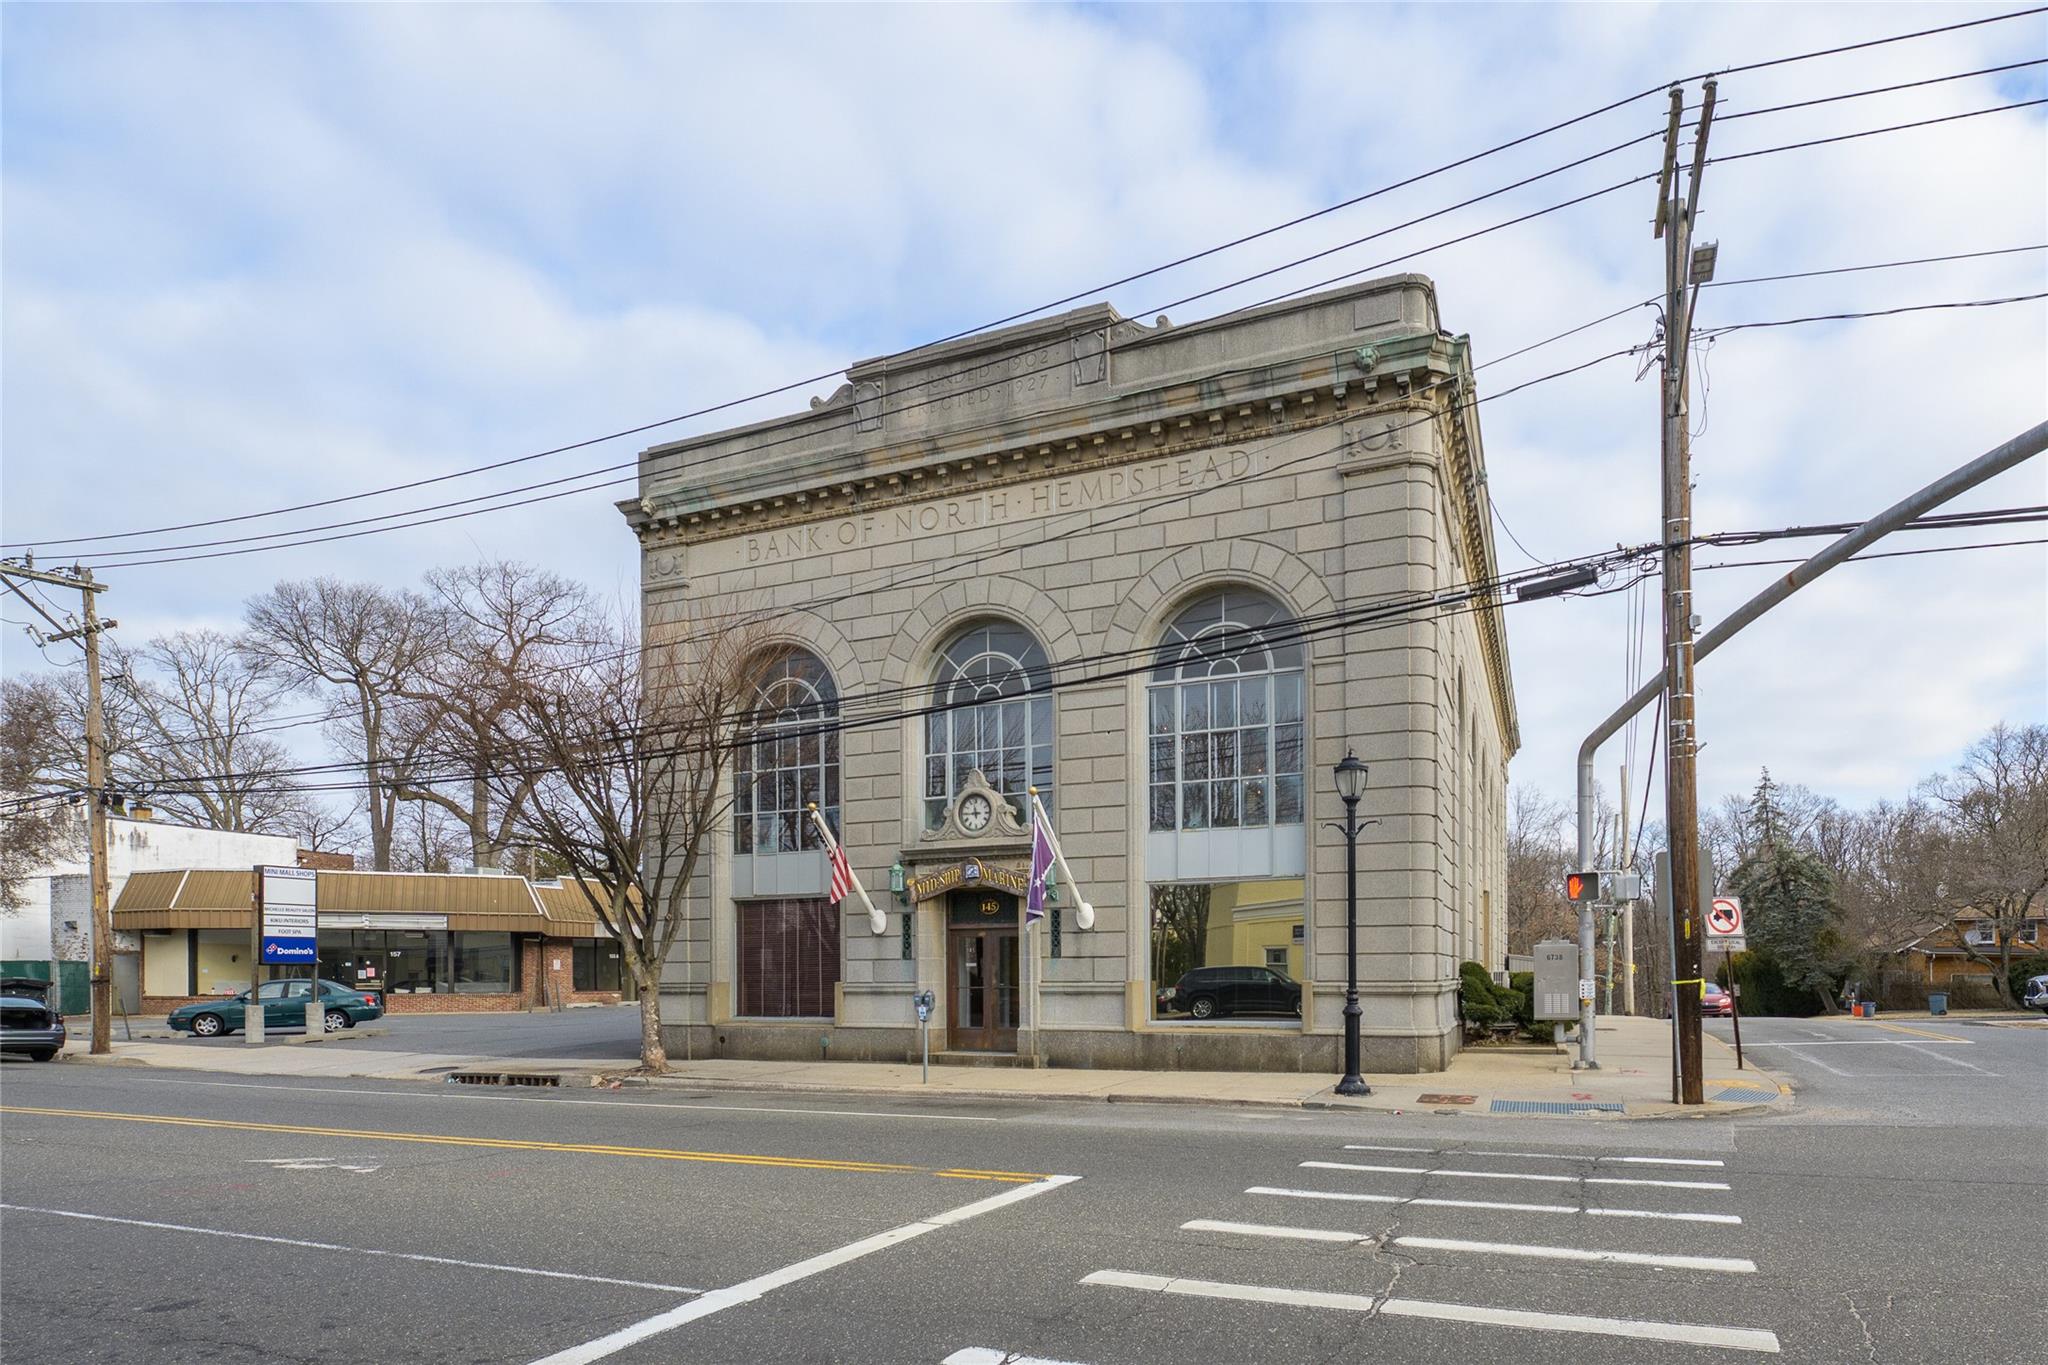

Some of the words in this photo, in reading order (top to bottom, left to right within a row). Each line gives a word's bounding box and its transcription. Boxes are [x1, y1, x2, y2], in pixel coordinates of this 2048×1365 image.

[748, 526, 822, 563] BANK
[838, 517, 874, 545] OF
[896, 492, 1008, 537] NORTH
[1030, 450, 1250, 513] HEMPSTEAD
[296, 870, 315, 878] SHOPS
[982, 867, 1024, 892] MARINE
[982, 902, 997, 911] 145
[277, 947, 313, 955] Domino's
